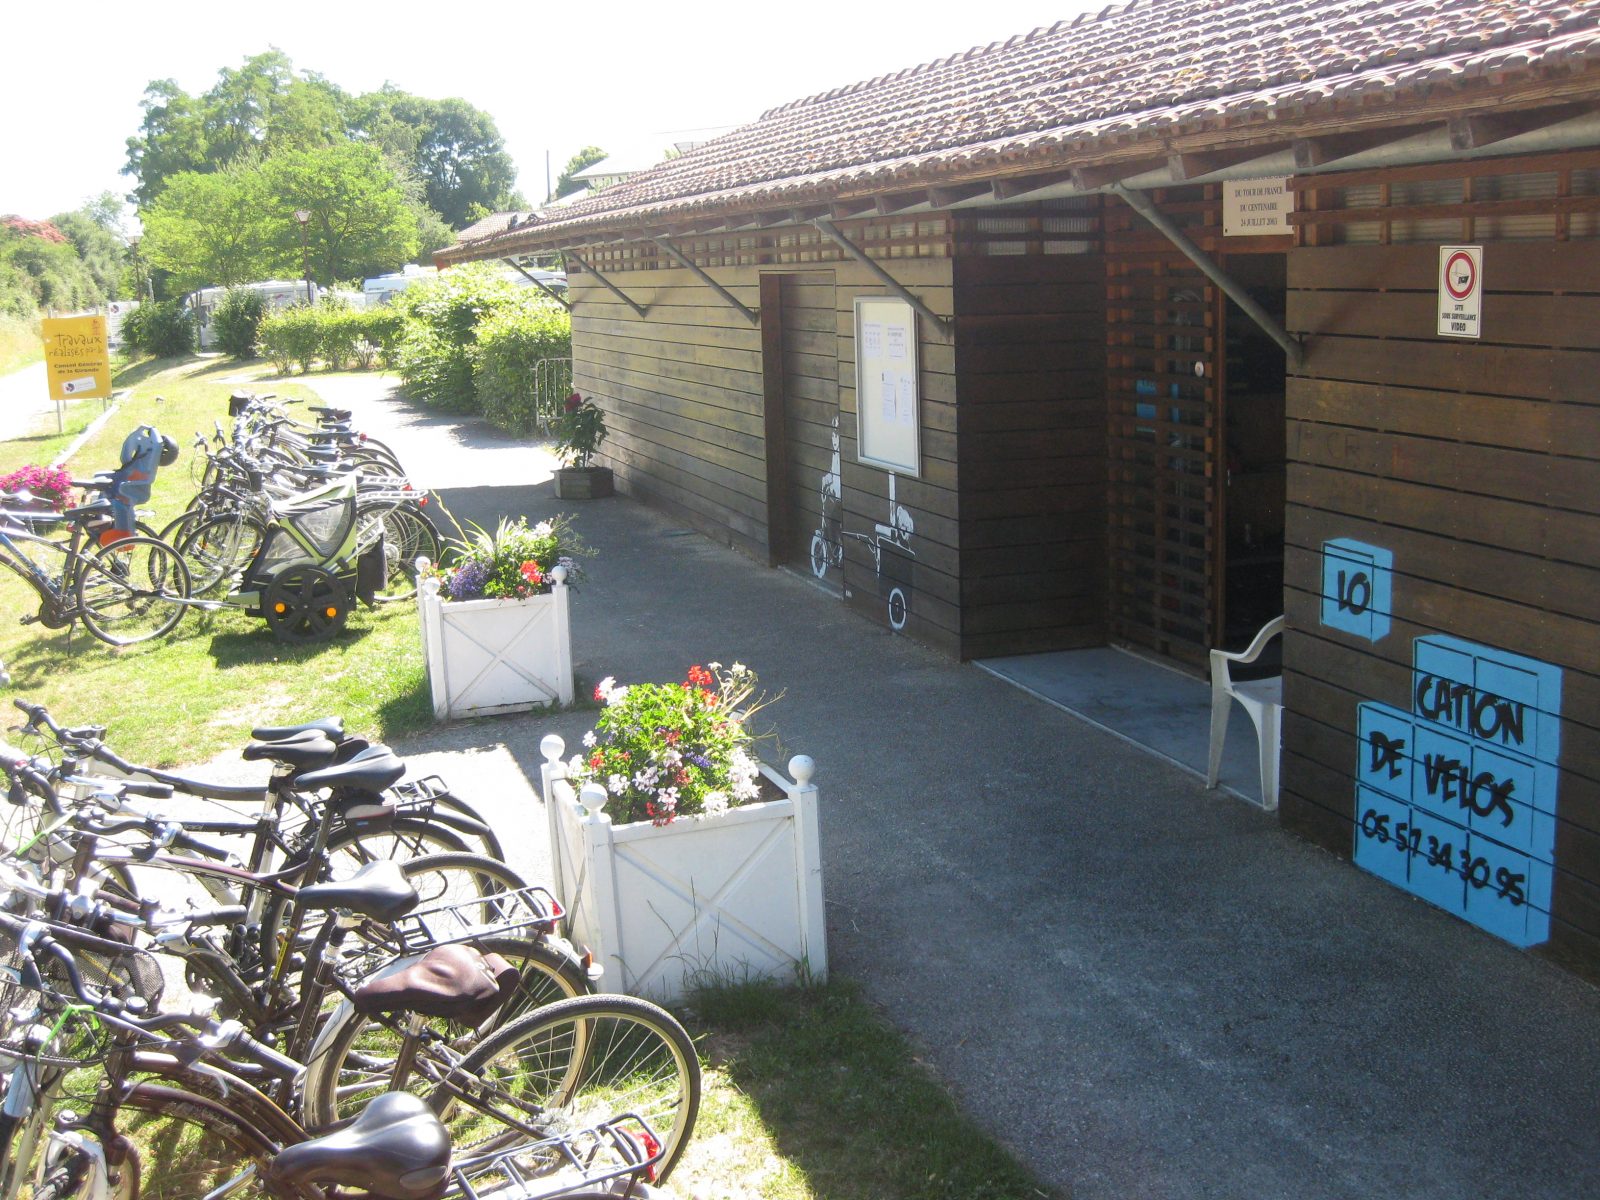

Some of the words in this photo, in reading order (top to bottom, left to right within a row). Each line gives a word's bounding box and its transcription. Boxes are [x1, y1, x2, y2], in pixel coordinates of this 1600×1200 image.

[1235, 189, 1242, 198] DU
[1243, 188, 1256, 197] TOUR
[1257, 187, 1264, 196] DE
[1264, 187, 1282, 196] FRANCE
[1240, 204, 1247, 212] DU
[1248, 203, 1277, 211] CENTENAIRE
[1247, 218, 1266, 226] JUILLET
[1451, 322, 1466, 332] VIDEO
[1337, 569, 1371, 615] LO
[1416, 674, 1526, 746] CATION
[1369, 730, 1405, 781] DE
[1424, 751, 1516, 829] VELOS
[1361, 808, 1389, 844] 05
[1395, 822, 1422, 859] 57
[1427, 835, 1452, 875] 34
[1459, 849, 1490, 890] 30
[1495, 866, 1526, 906] 95
